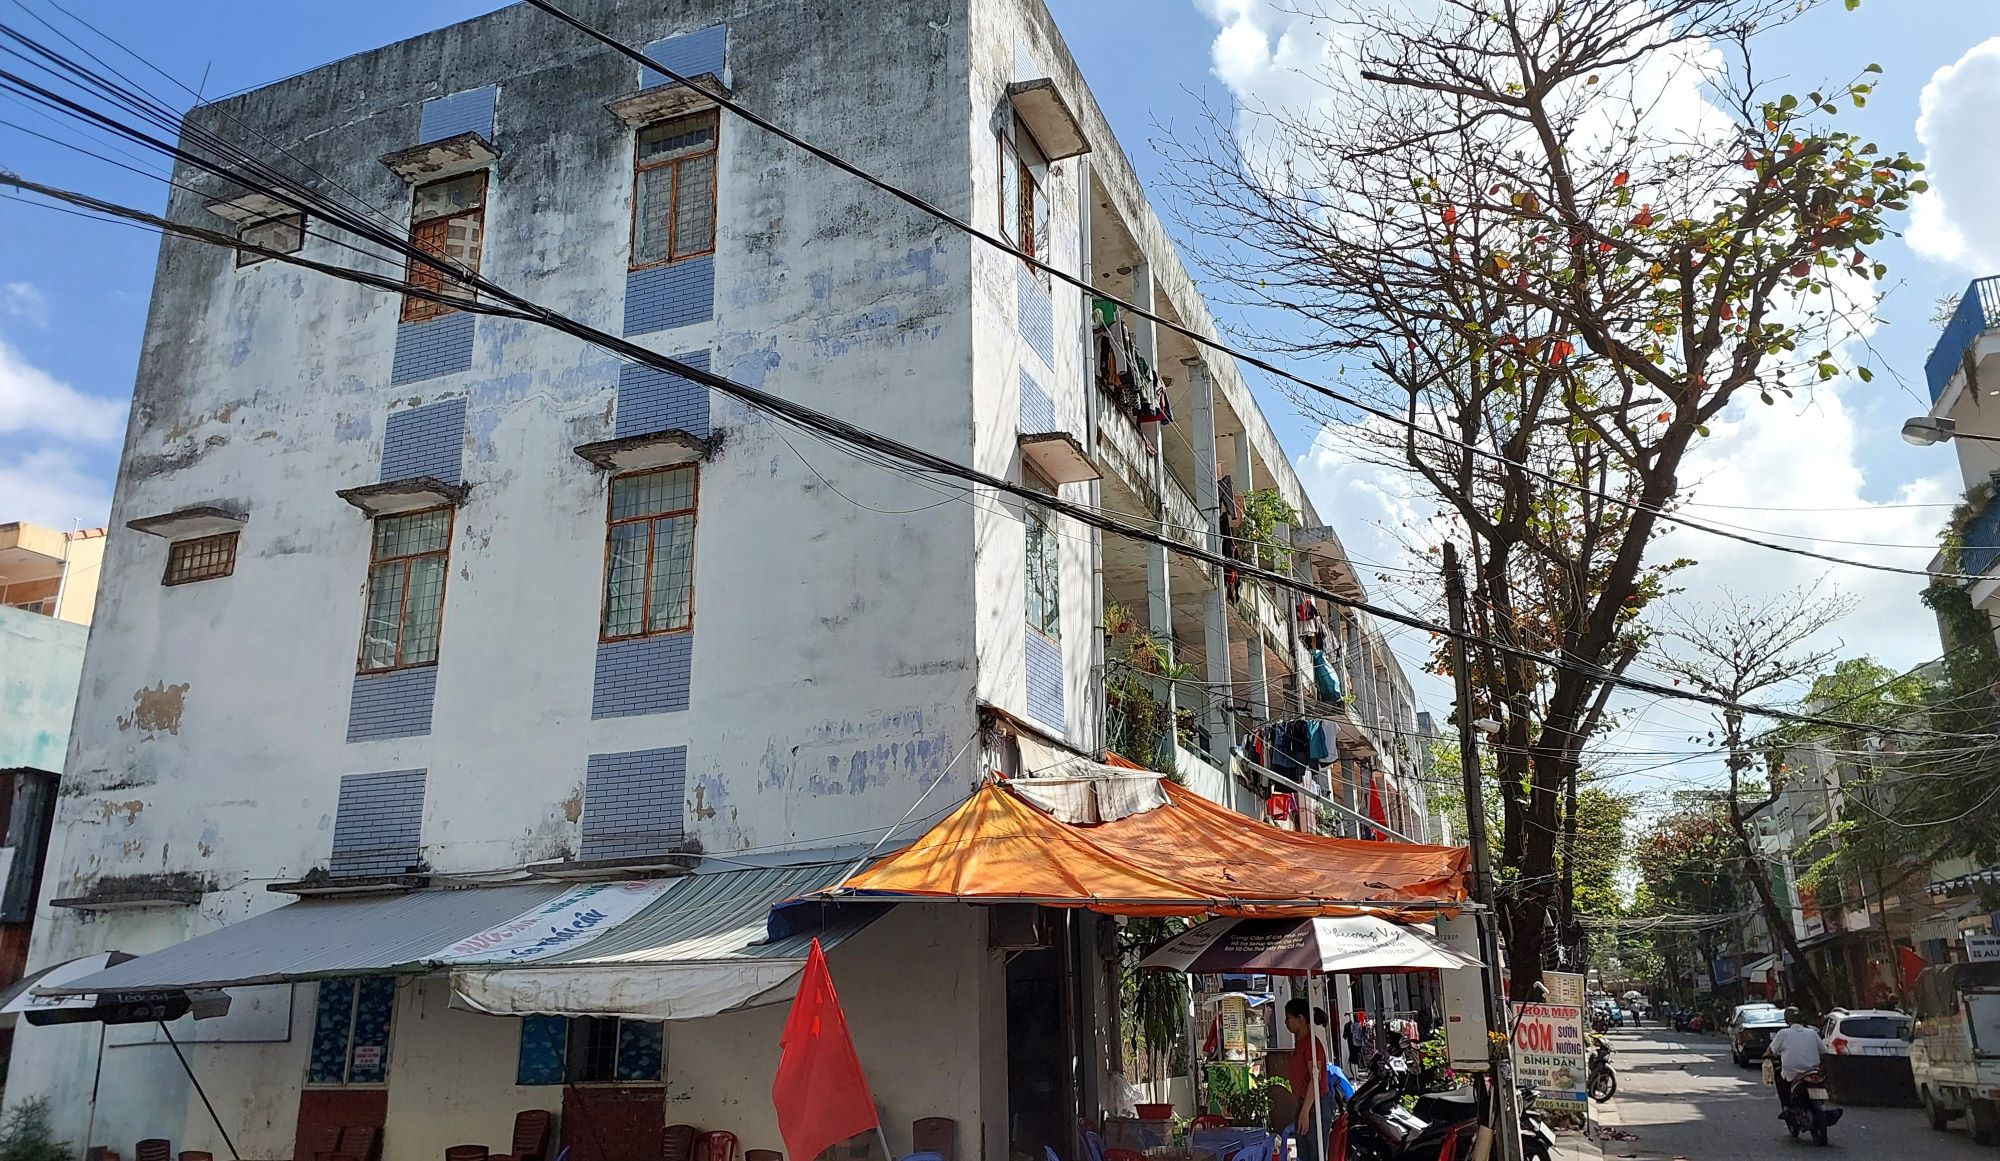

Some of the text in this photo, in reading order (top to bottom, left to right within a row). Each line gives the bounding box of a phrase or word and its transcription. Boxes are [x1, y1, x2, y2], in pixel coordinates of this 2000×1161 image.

[1516, 1018, 1578, 1052] CƠM SƯỜN
[1556, 1040, 1581, 1055] NƯỚNG
[1524, 1054, 1576, 1067] BÌNH DÂN
